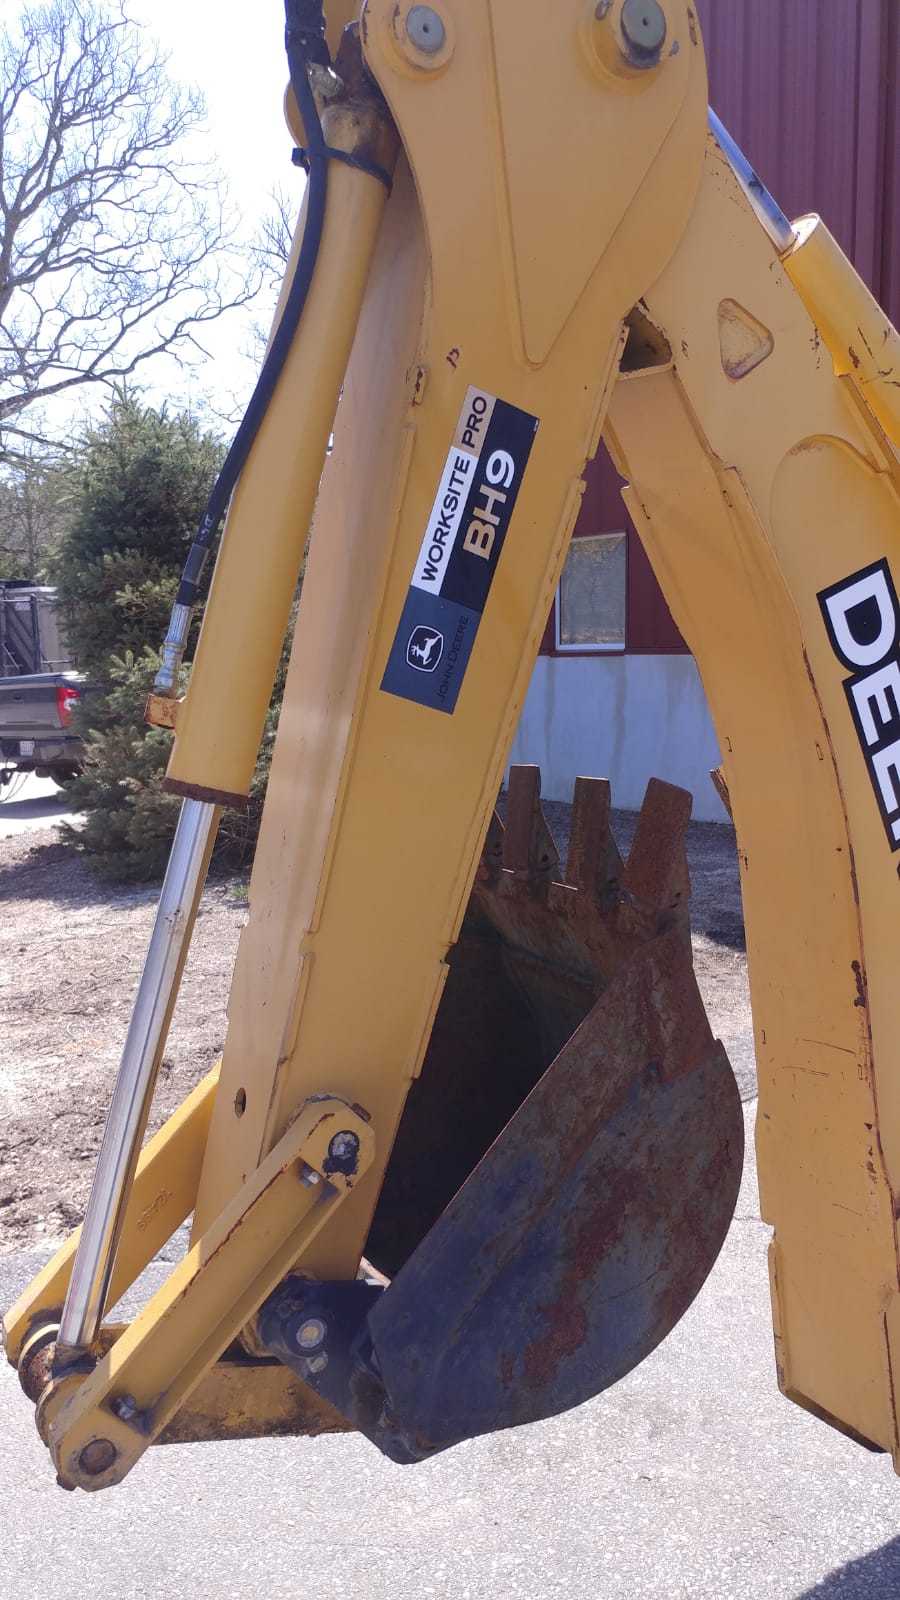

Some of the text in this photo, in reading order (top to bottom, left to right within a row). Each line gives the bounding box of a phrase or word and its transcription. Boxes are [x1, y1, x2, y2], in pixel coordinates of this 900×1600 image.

[420, 396, 487, 582] WORKSITE PRO
[462, 449, 516, 560] BH9
[448, 616, 469, 663] DEERE
[821, 564, 900, 845] DE
